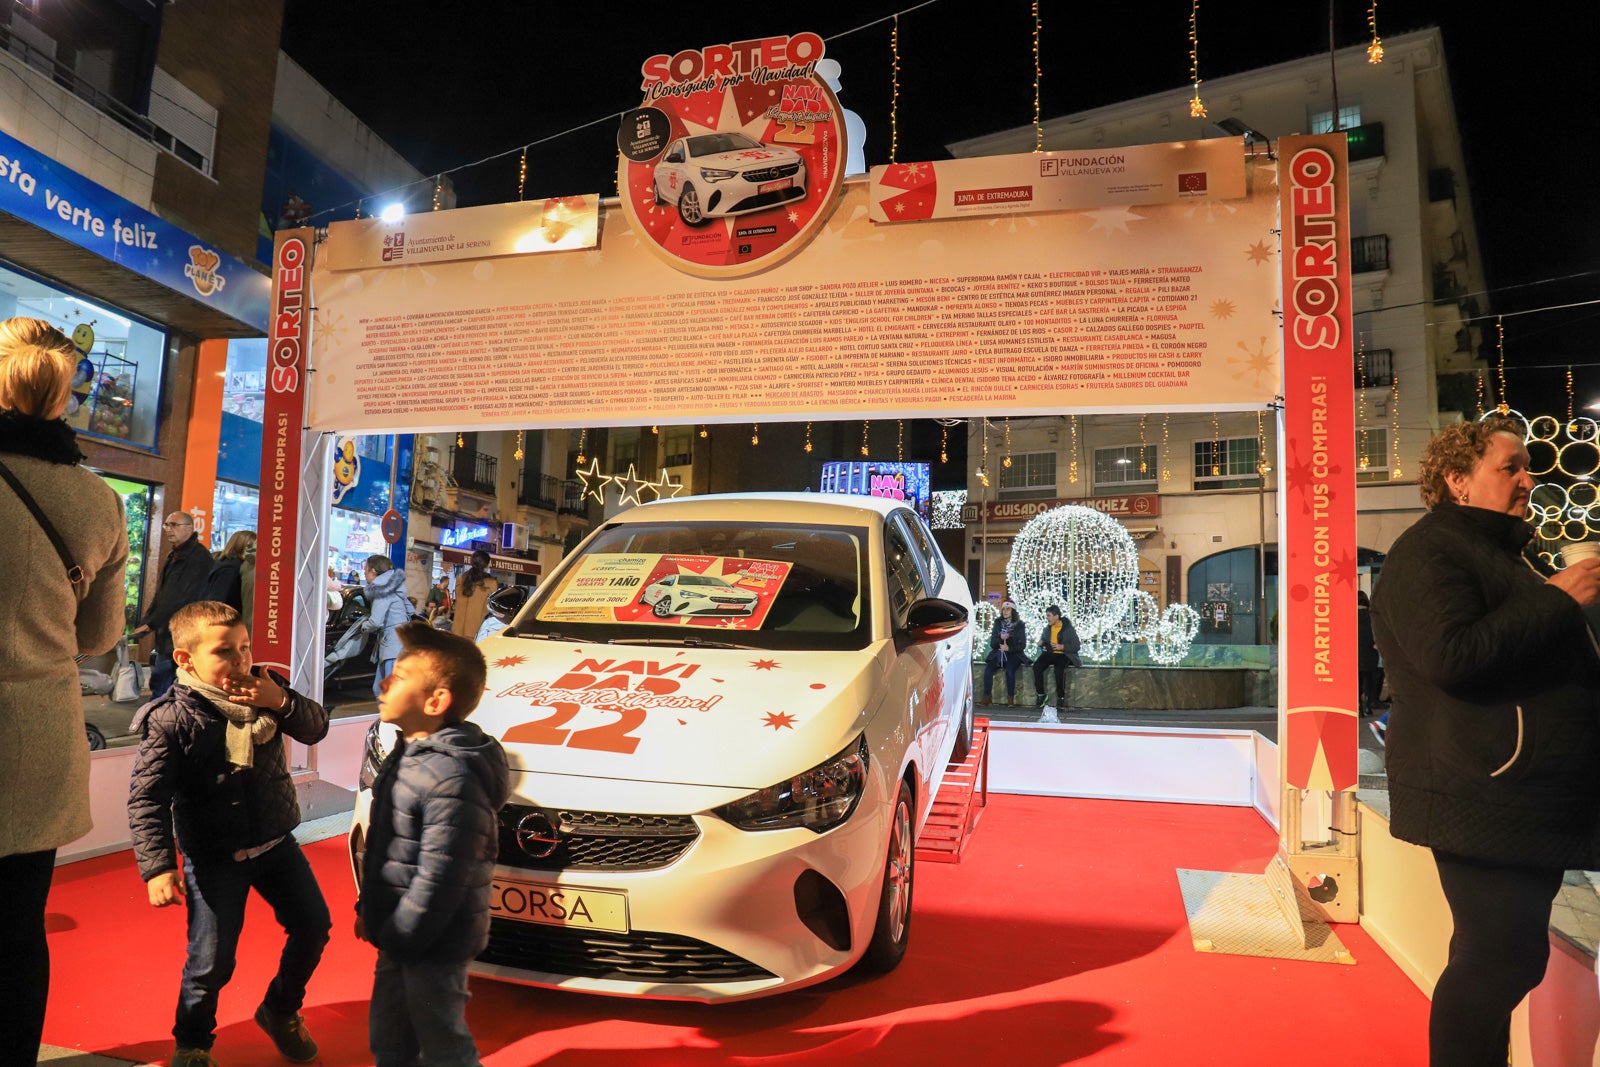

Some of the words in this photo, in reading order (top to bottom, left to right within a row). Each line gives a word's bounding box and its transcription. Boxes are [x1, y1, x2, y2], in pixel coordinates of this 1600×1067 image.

[641, 32, 825, 91] SORTEO
[644, 76, 716, 100] ¡Consíguelo
[721, 75, 744, 91] por
[751, 60, 818, 85] Navidad!
[782, 85, 823, 100] NAVI
[780, 98, 821, 113] DAD
[774, 119, 815, 144] 22
[1060, 155, 1125, 168] FUNDACIÓN
[1060, 168, 1110, 176] VILLANUEVA
[957, 194, 975, 203] JUNTA
[986, 190, 1029, 200] EXTREMADURA
[45, 189, 105, 237] verte
[112, 218, 158, 249] feliz
[1289, 147, 1341, 350] SORTEO
[185, 265, 223, 289] PLANET
[856, 280, 878, 288] ATELIER
[928, 276, 949, 284] NICESA
[1157, 265, 1203, 273] STRAVAGANZZA
[972, 283, 995, 291] JOYERÍA
[996, 282, 1020, 290] BENÍTEZ
[1109, 277, 1126, 285] TALIA
[1133, 275, 1169, 284] FERRETERÍA
[988, 291, 1015, 299] ESTÉTICA
[1062, 288, 1085, 296] IMAGEN
[1086, 287, 1117, 295] PERSONAL
[1170, 284, 1191, 292] BAZAR
[272, 238, 305, 393] SORTEO
[802, 309, 831, 317] CAFETERÍA
[831, 308, 859, 316] CAPRICHO
[906, 304, 938, 312] MANDUKAR
[1028, 299, 1048, 307] PECAS
[1156, 294, 1189, 302] COTIDIANO
[997, 309, 1032, 317] ESPECIALES
[957, 320, 996, 328] RESTAURANTE
[1034, 317, 1072, 325] MONTADITOS
[1104, 314, 1138, 322] CHURRERÍA
[1026, 336, 1055, 344] ESTILISTA
[1103, 333, 1143, 341] CASABLANCA
[1150, 332, 1176, 340] MAGUSA
[842, 352, 869, 360] IMPRENTA
[1085, 343, 1121, 351] FERRETERÍA
[888, 377, 924, 385] CARPINTERÍA
[1069, 372, 1105, 380] FOTOGRAFÍA
[1147, 370, 1175, 378] COCKTAIL
[1017, 364, 1054, 372] ROTULACIÓN
[1135, 361, 1159, 369] OFICINA
[1166, 360, 1202, 368] POMODORO
[1311, 375, 1328, 478] COMPRAS!
[275, 413, 288, 490] COMPRAS!
[871, 475, 904, 490] NAVI
[273, 494, 283, 522] TUS
[994, 502, 1048, 517] GUISADO
[1312, 484, 1329, 519] TUS
[271, 526, 282, 557] CON
[1313, 525, 1330, 567] CON
[495, 561, 524, 571] PASTELERIA
[267, 561, 280, 644] ¡PARTICIPA
[1313, 573, 1334, 683] ¡PARTICIPA
[569, 658, 702, 678] NAVI
[549, 672, 681, 696] DAD
[500, 699, 647, 755] 22
